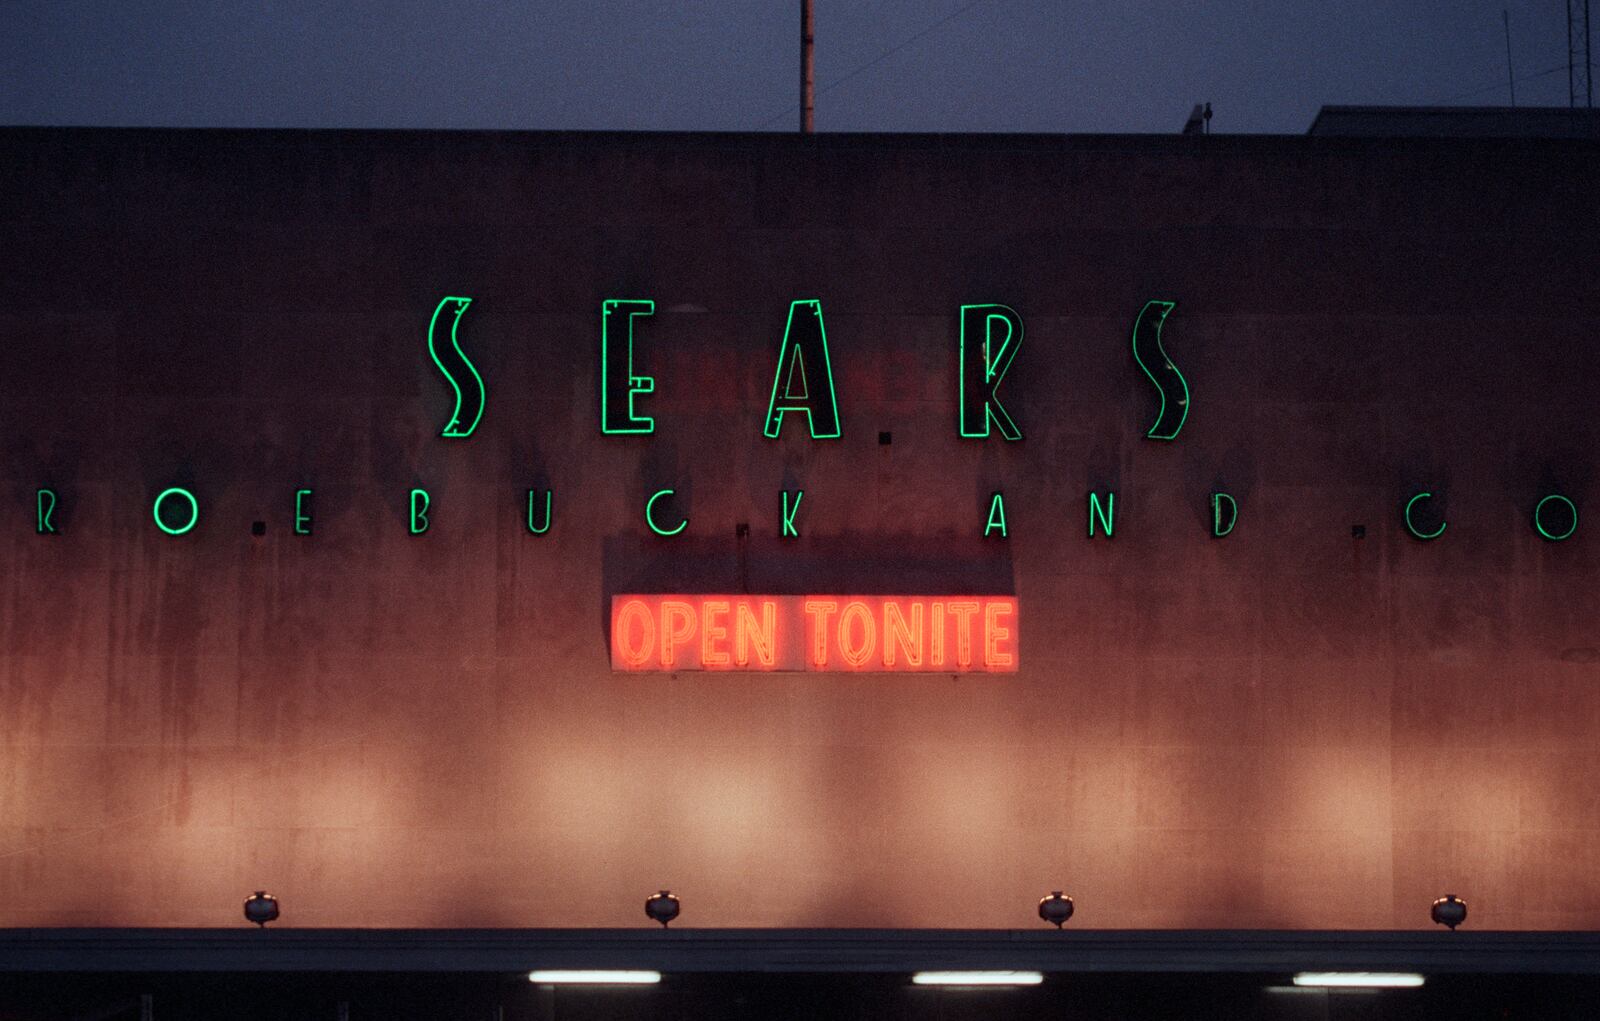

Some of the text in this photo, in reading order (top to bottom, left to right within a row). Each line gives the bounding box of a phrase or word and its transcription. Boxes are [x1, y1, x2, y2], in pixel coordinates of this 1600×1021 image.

[427, 296, 1191, 441] SEARS
[37, 486, 1577, 540] ROEBUCK AND CO
[615, 600, 1014, 667] OPEN TONITE
